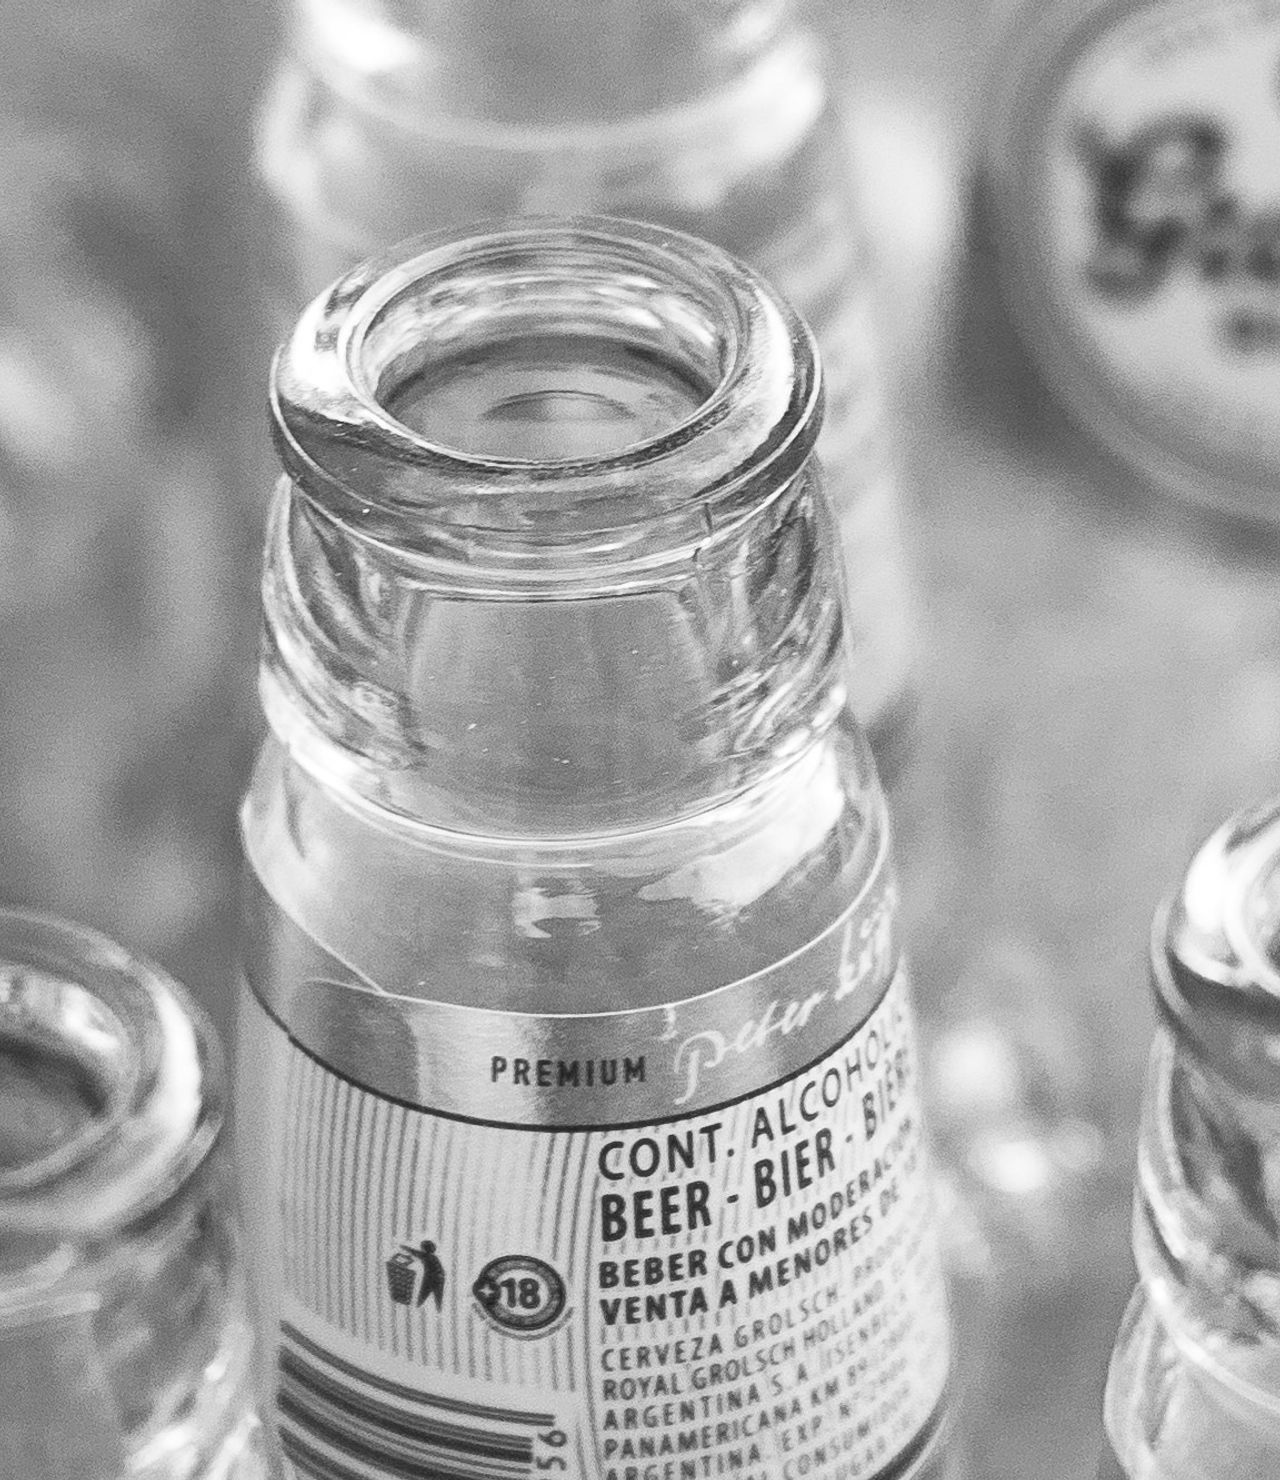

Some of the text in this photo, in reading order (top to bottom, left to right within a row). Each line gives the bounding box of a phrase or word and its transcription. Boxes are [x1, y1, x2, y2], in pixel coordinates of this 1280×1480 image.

[490, 1055, 648, 1089] PREMIUM
[598, 1122, 735, 1181] CONT.
[601, 1128, 836, 1243] BEER BIER
[599, 1225, 777, 1290] BEBER CON
[600, 1286, 709, 1326] VENTA
[719, 1278, 738, 1309] A
[749, 1207, 873, 1299] MENORES
[499, 1278, 543, 1311] 18
[601, 1333, 722, 1373] CERVEZA
[602, 1373, 683, 1401] ROYAL
[691, 1336, 797, 1390] GROLSCH
[603, 1383, 760, 1432] ARGENTINA
[604, 1398, 802, 1460] PANAMERICANA
